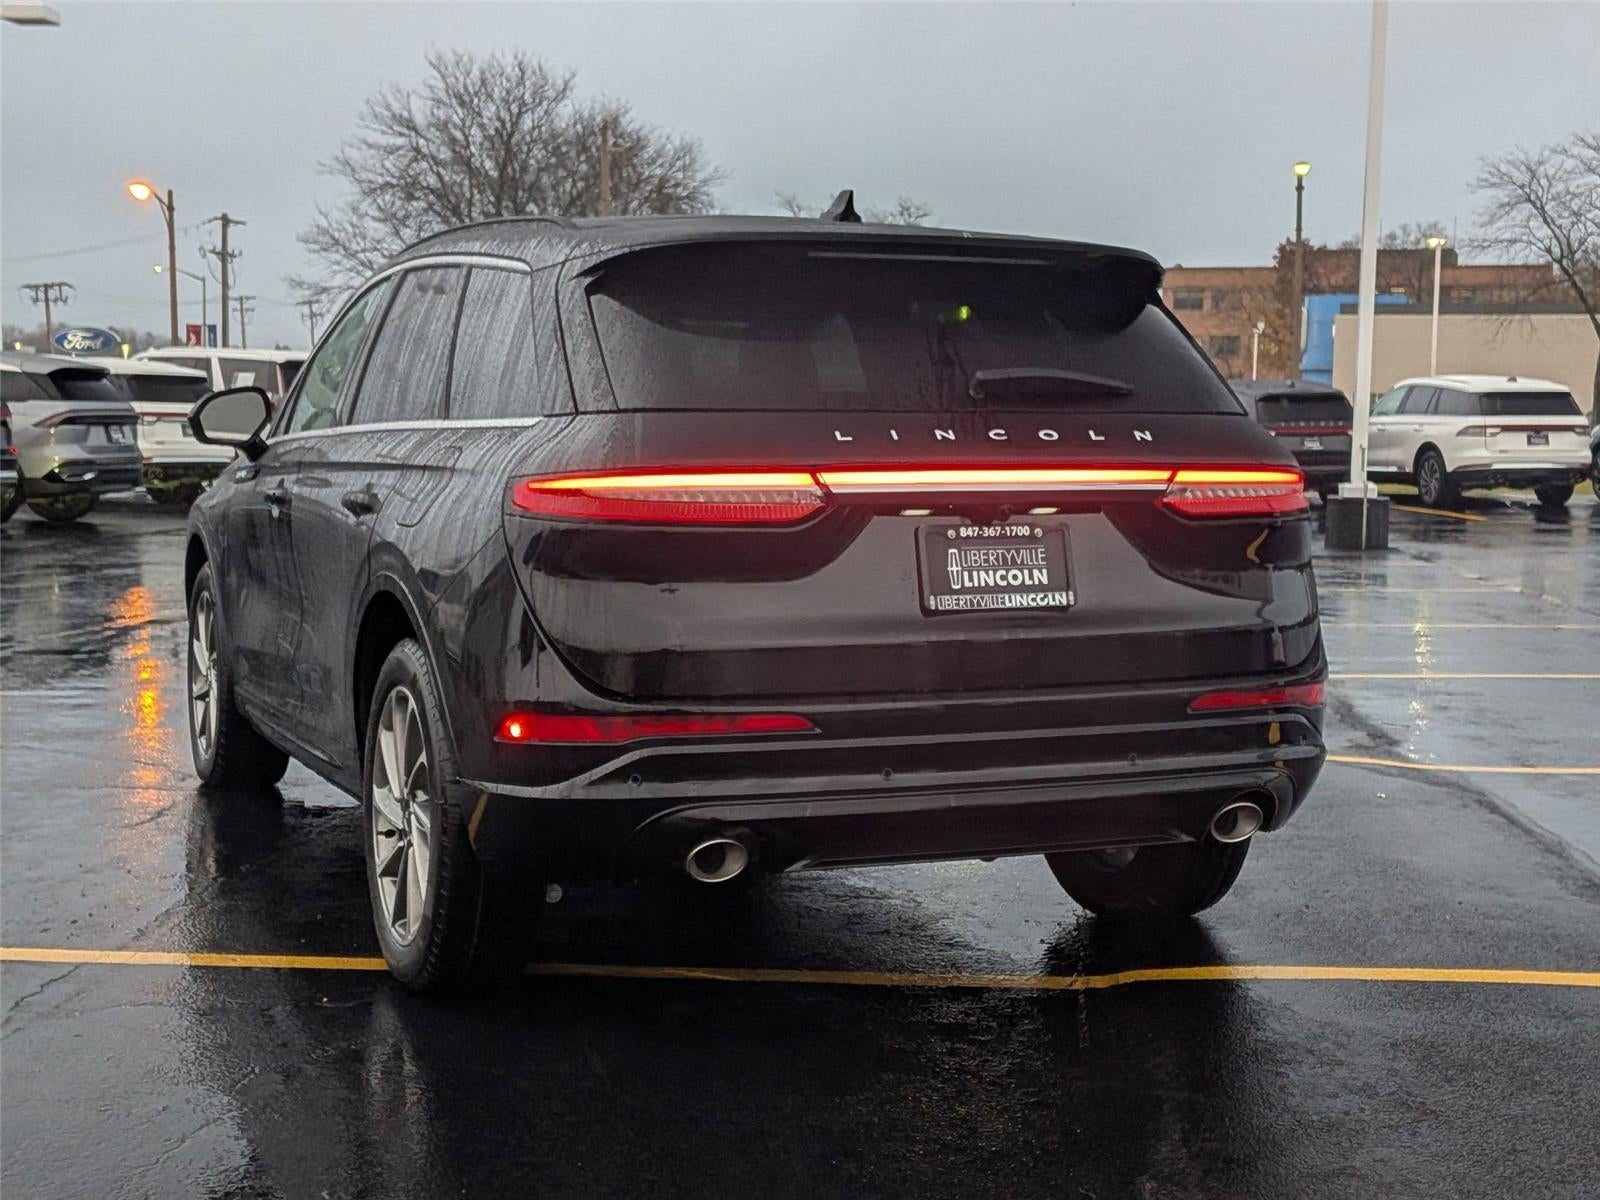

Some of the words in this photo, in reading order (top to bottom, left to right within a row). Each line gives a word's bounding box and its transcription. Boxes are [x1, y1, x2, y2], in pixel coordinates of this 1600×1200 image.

[64, 331, 103, 350] Ford
[834, 428, 1153, 441] LINCOLN
[959, 525, 1030, 537] 847-367-1700
[961, 548, 1047, 567] LIBERTYVILLE
[963, 568, 1049, 588] LINCOLN
